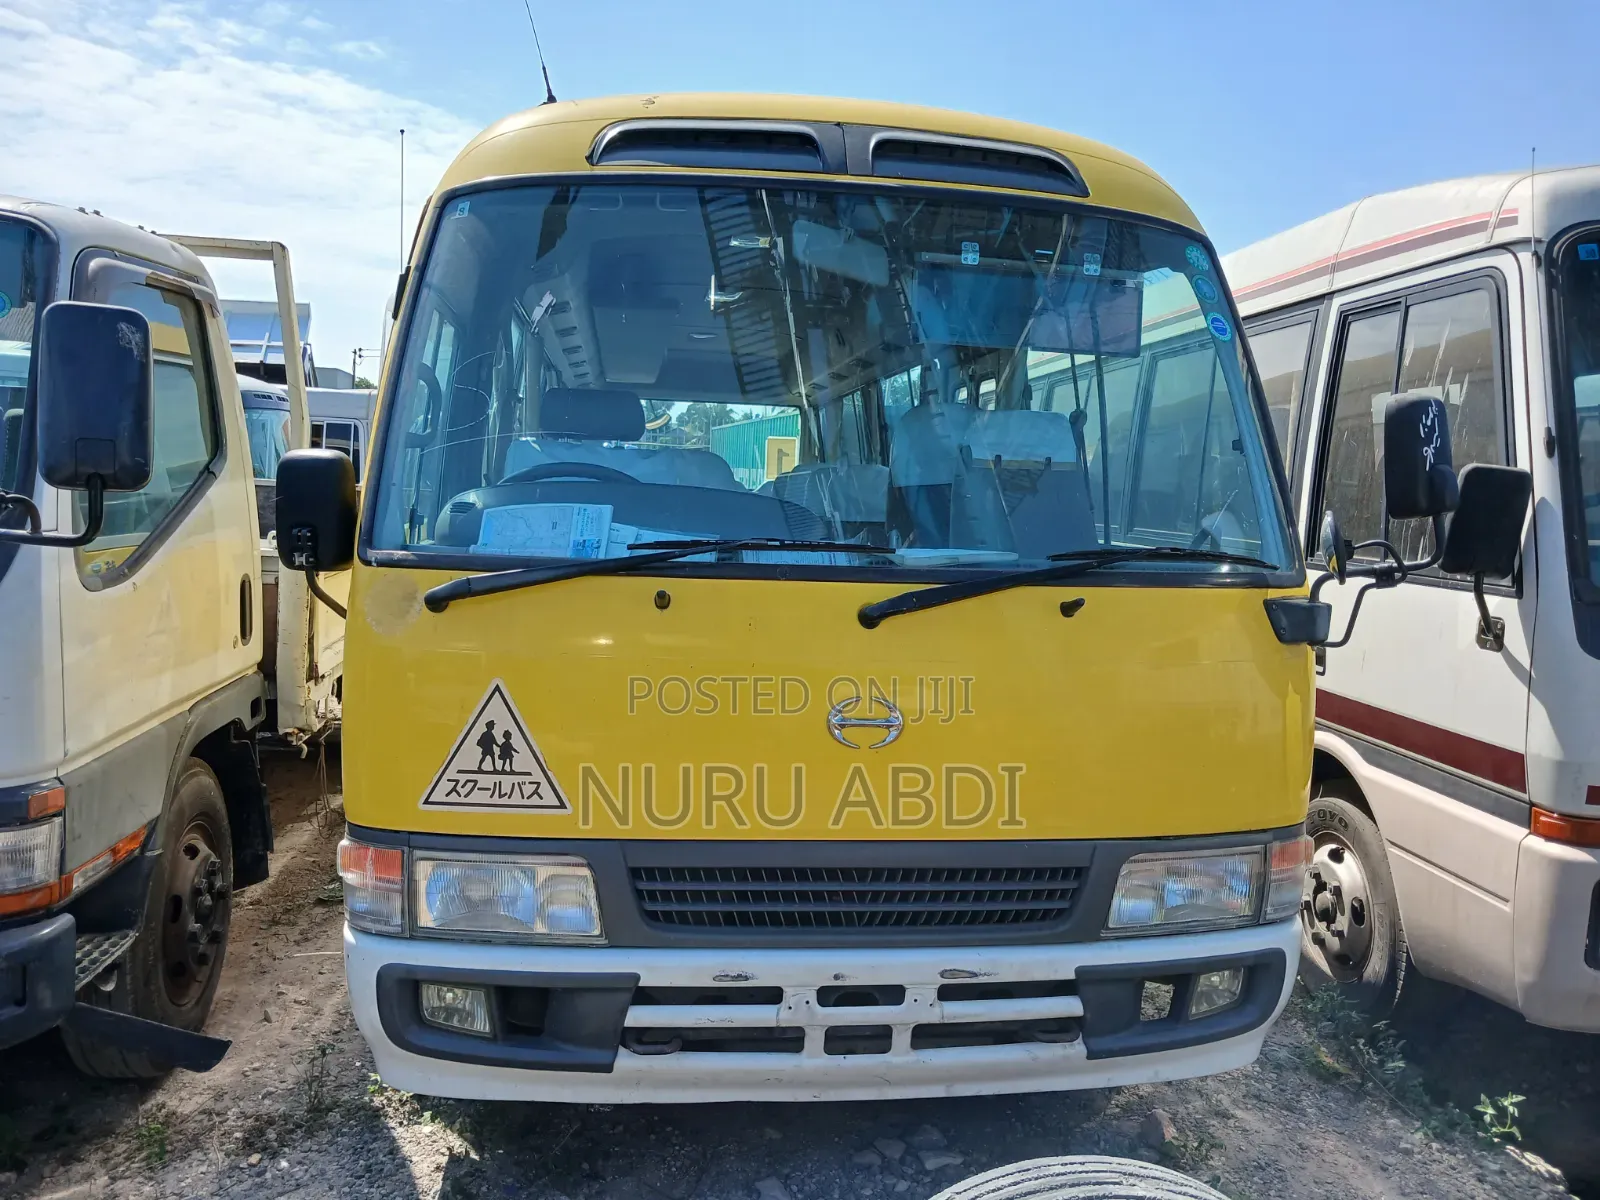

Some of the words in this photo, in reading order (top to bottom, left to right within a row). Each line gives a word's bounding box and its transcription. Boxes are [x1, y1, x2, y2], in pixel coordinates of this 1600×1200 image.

[445, 778, 544, 800] スクールバス
[1306, 808, 1349, 832] TOYO
